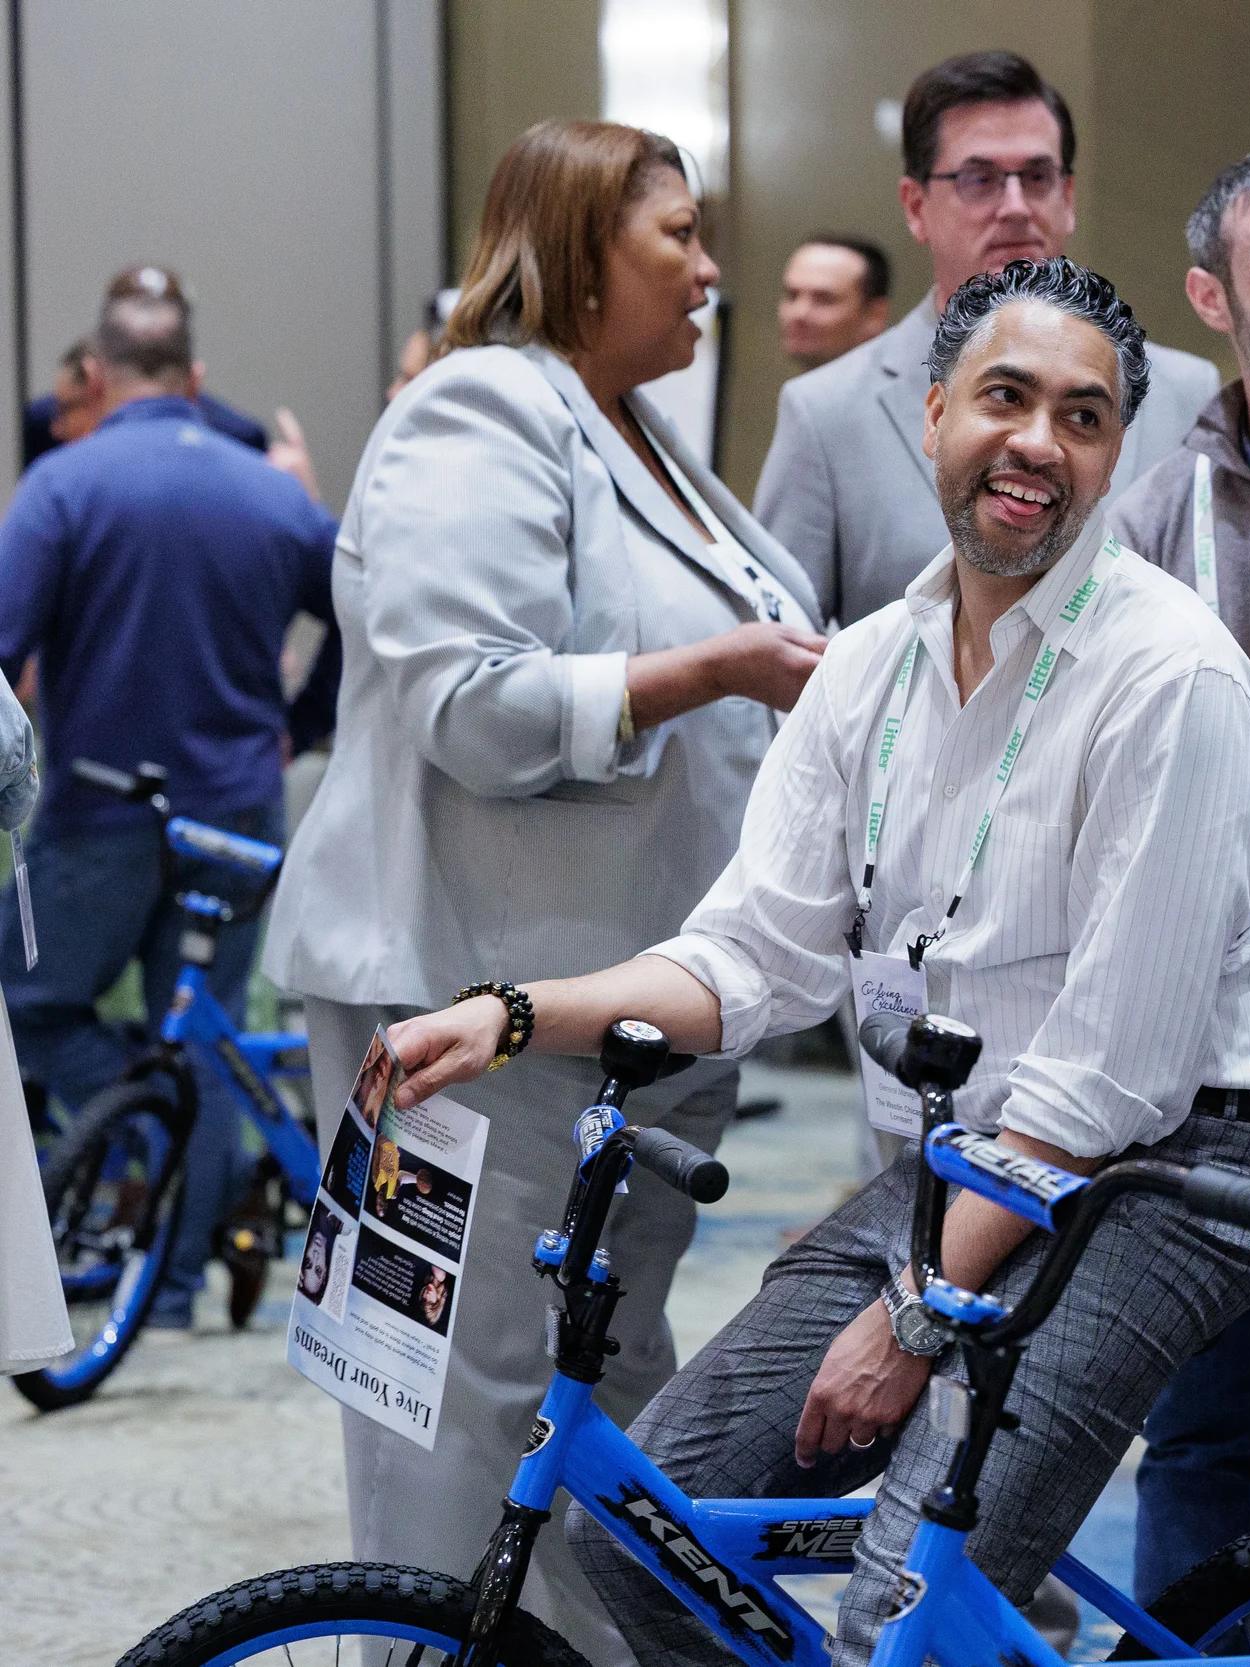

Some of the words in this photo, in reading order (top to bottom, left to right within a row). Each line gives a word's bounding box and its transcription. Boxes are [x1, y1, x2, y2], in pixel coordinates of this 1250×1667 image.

[1059, 572, 1100, 624] Littler
[898, 645, 917, 691] ittler
[1025, 643, 1057, 701] Littler
[879, 716, 901, 775] Littler
[997, 724, 1021, 782] Littler
[861, 980, 902, 999] Evolving
[871, 995, 919, 1015] Excellence
[875, 1097, 886, 1107] The
[886, 1099, 903, 1111] Westin
[903, 1104, 923, 1119] Chicag
[890, 1111, 913, 1125] Lombard
[580, 1112, 605, 1158] METAL
[293, 1325, 347, 1382] Dreams
[349, 1366, 389, 1408] Your
[396, 1389, 431, 1428] Live
[772, 1518, 865, 1534] STREET
[625, 1498, 789, 1640] KENT
